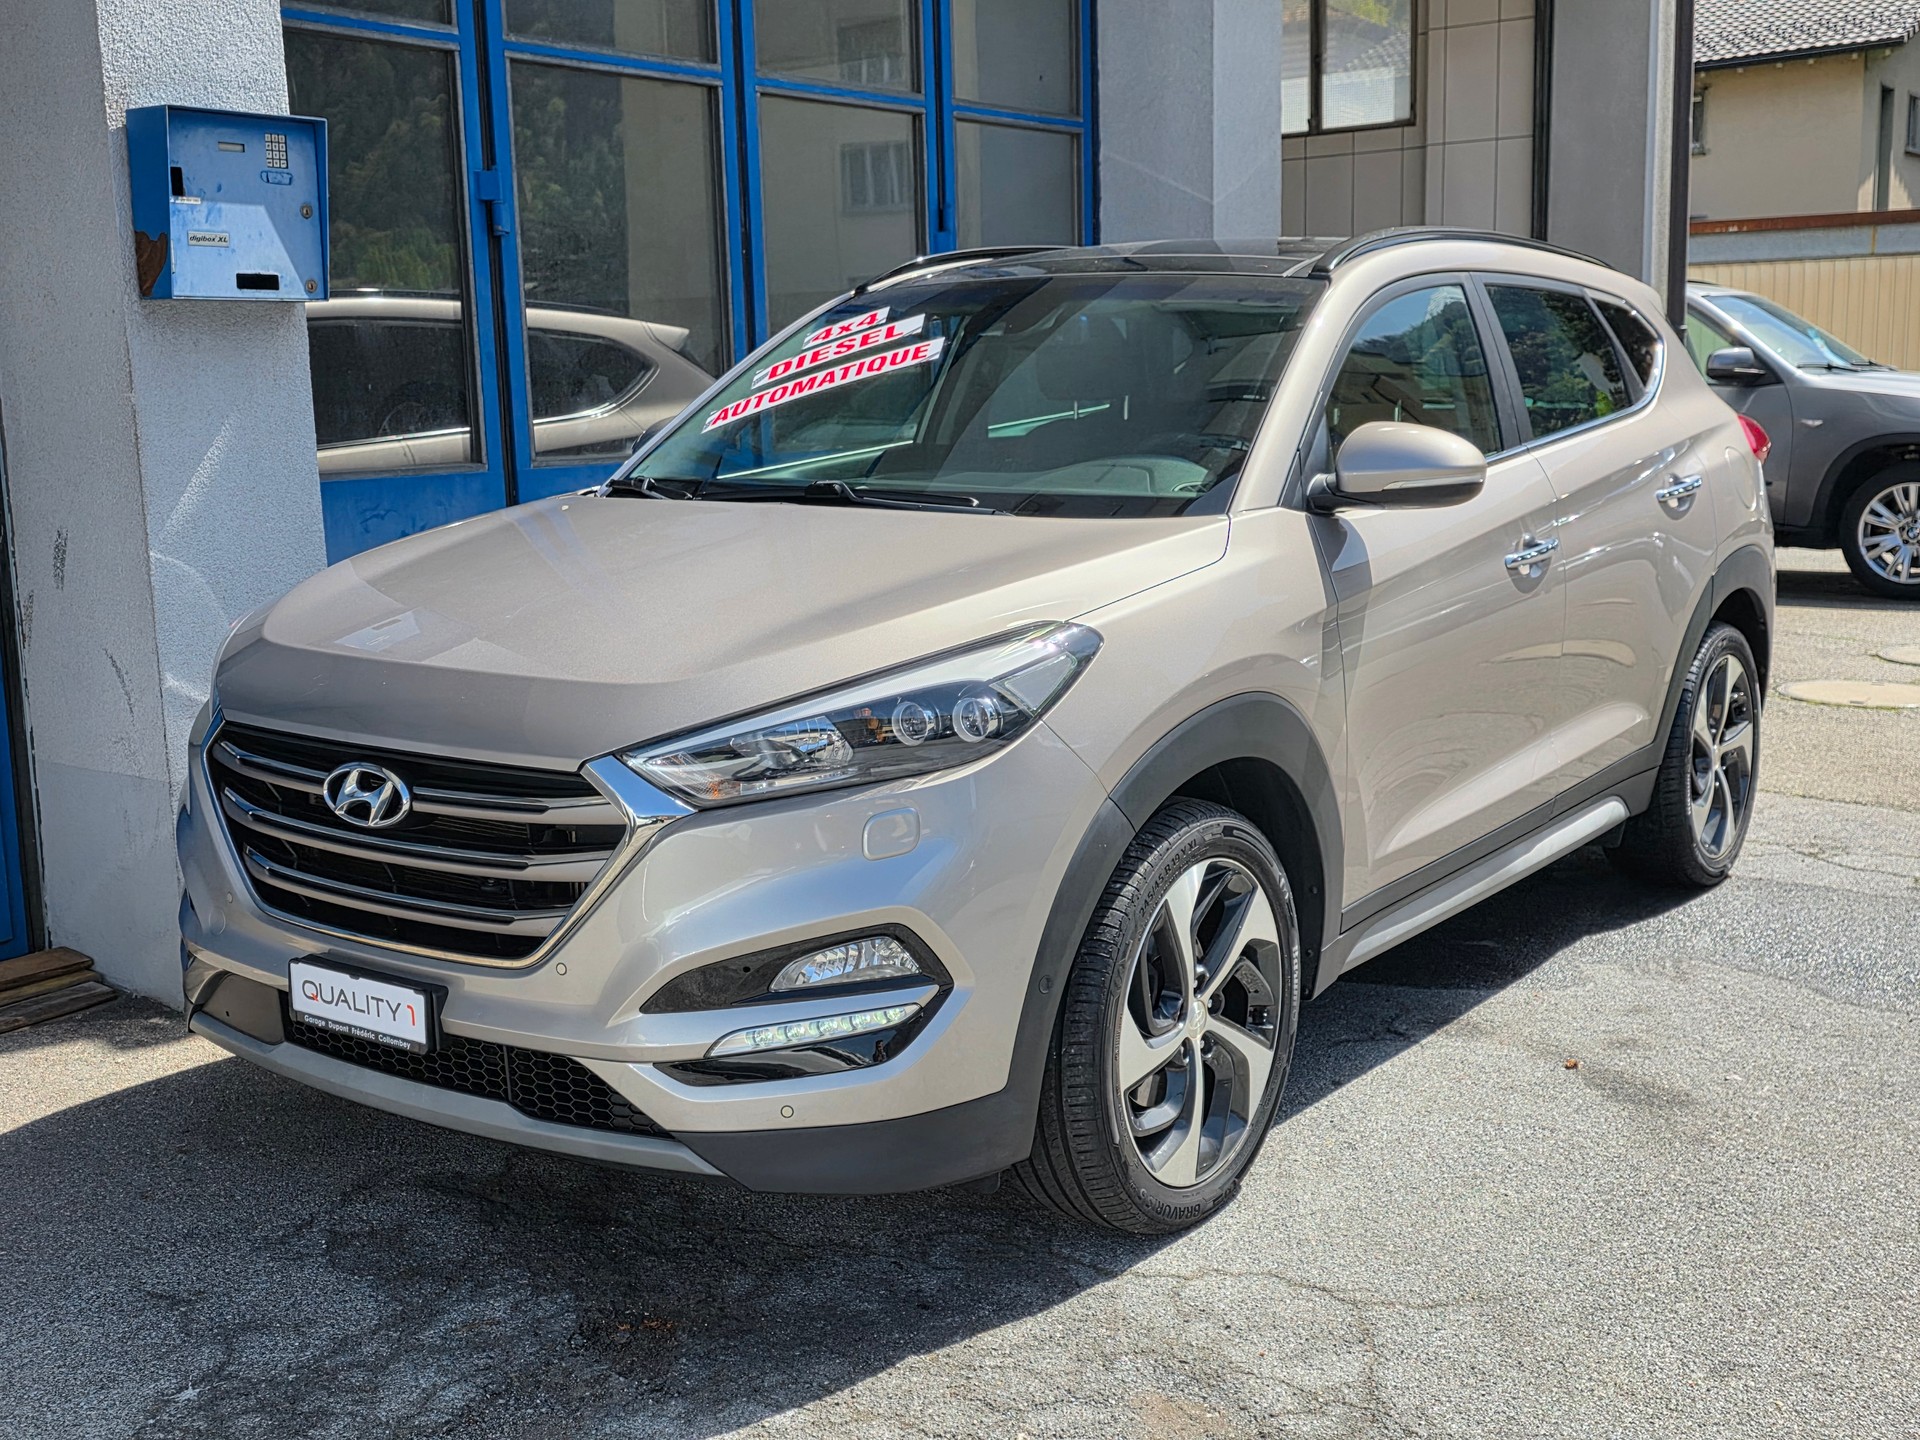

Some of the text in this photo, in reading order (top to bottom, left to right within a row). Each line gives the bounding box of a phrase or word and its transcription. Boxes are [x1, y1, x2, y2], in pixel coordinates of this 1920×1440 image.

[190, 235, 216, 243] digibox
[809, 312, 879, 343] 4x4
[767, 325, 904, 381] DIESEL
[710, 343, 931, 427] AUTOMATIQUE
[302, 980, 416, 1027] QUALITY 1
[304, 1014, 411, 1050] Garage Dupont Frédéric Collombey
